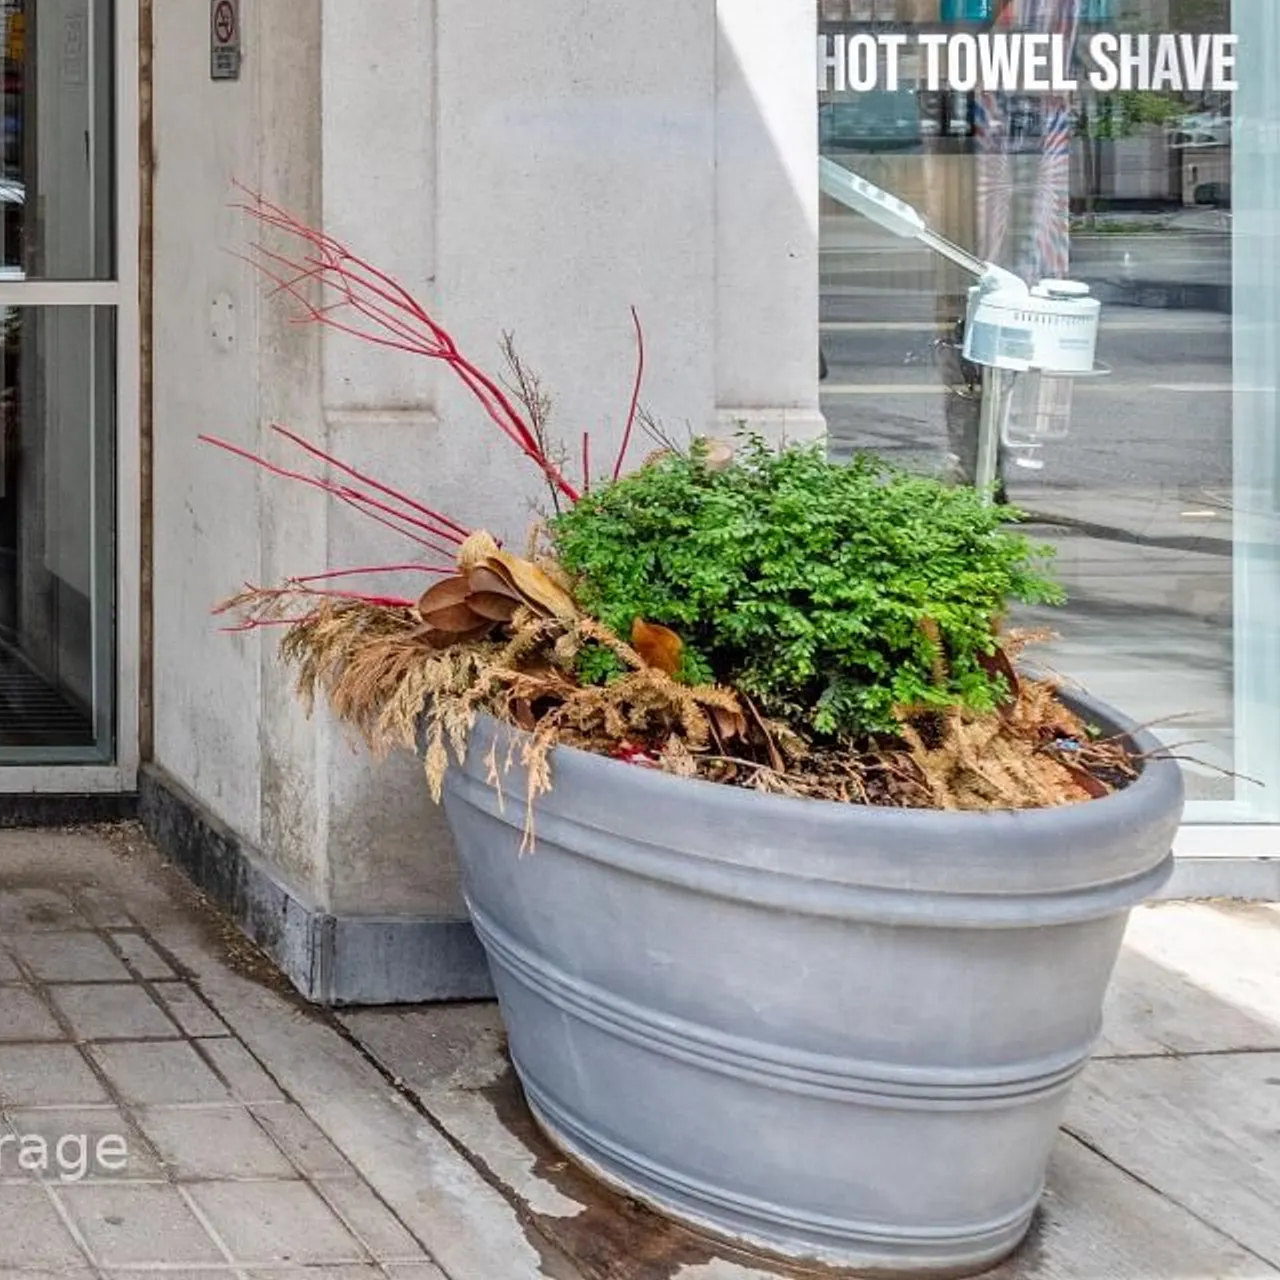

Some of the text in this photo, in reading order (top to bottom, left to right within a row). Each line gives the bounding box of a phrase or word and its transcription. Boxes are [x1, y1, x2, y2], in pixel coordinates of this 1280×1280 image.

[818, 33, 1238, 91] HOT TOWEL SHAVE
